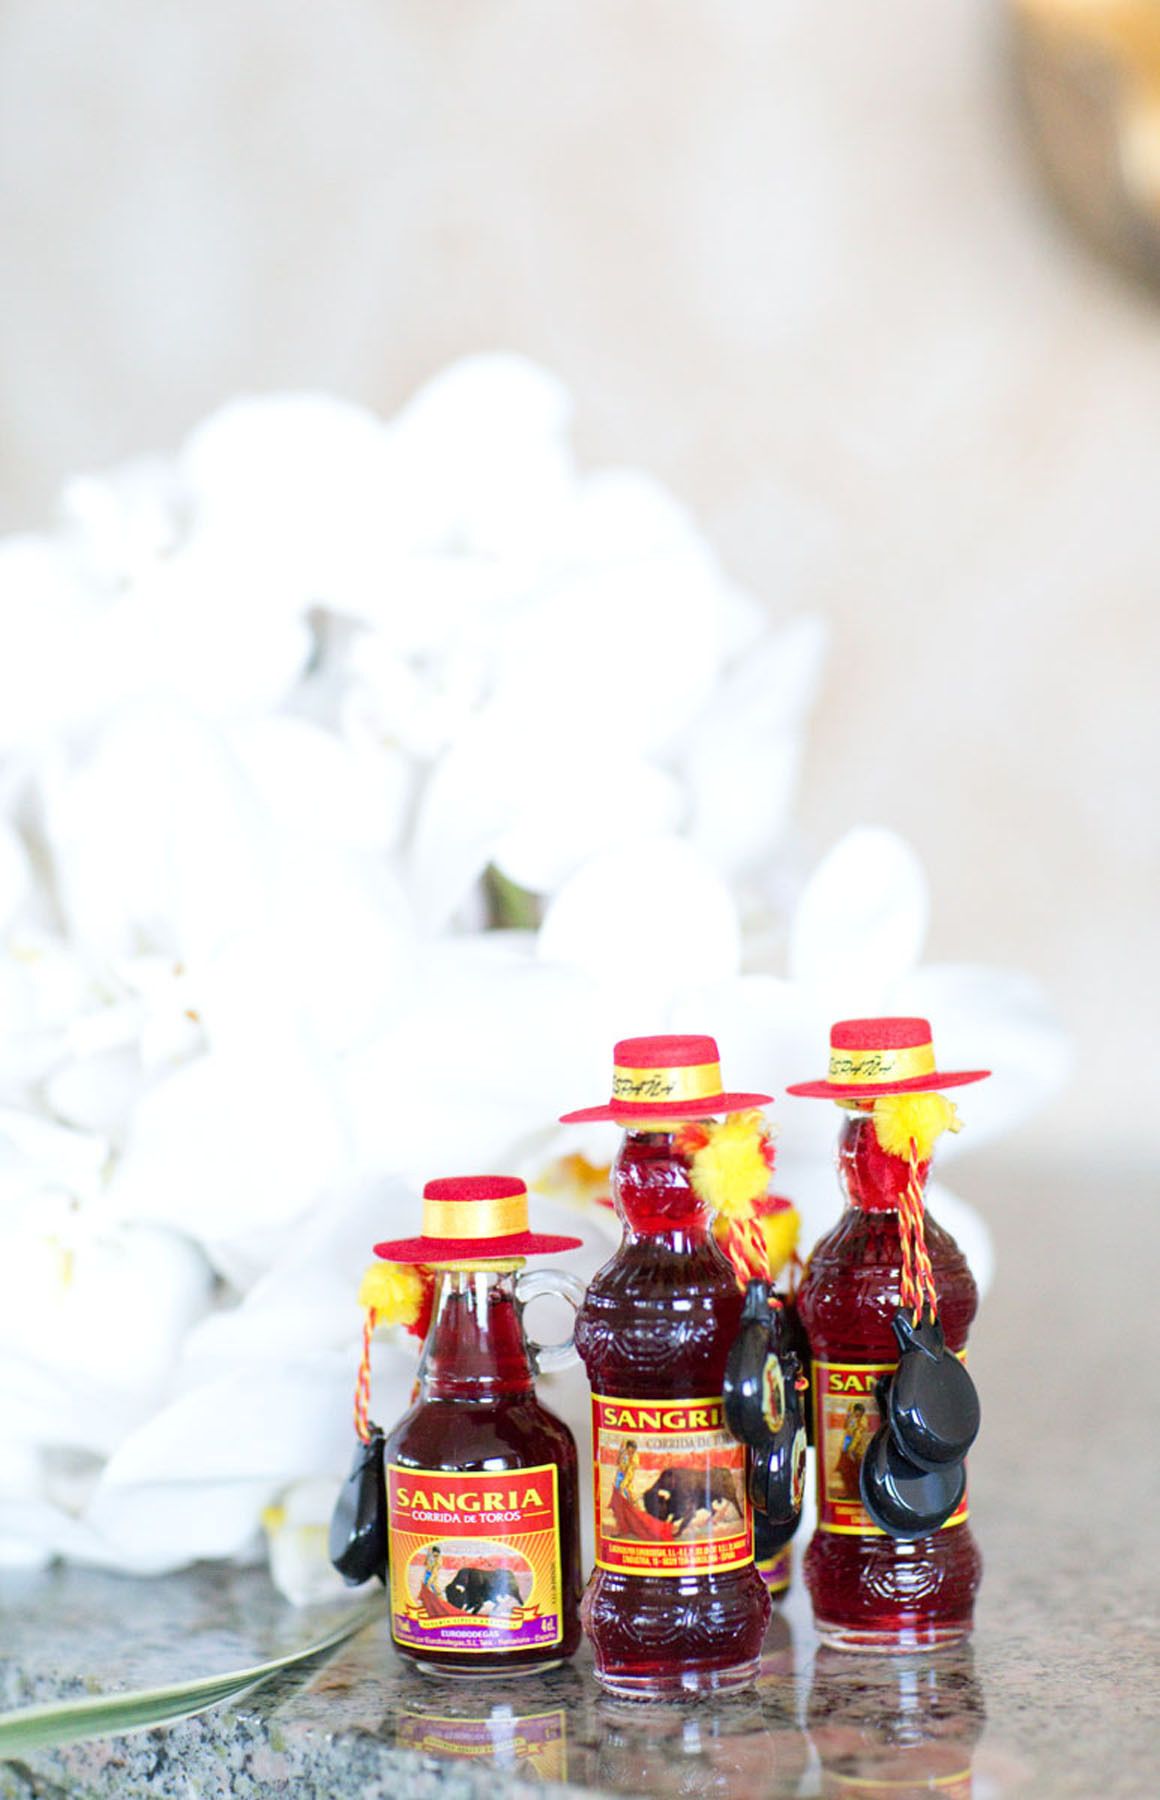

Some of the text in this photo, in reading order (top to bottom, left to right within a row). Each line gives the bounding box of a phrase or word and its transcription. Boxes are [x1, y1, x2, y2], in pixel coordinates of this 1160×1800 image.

[603, 1407, 724, 1429] SANGRI
[396, 1487, 545, 1512] SANGRIA
[411, 1511, 462, 1524] CORRIDA
[478, 1510, 522, 1523] TOROS
[440, 1629, 500, 1638] EUROBODEGAS
